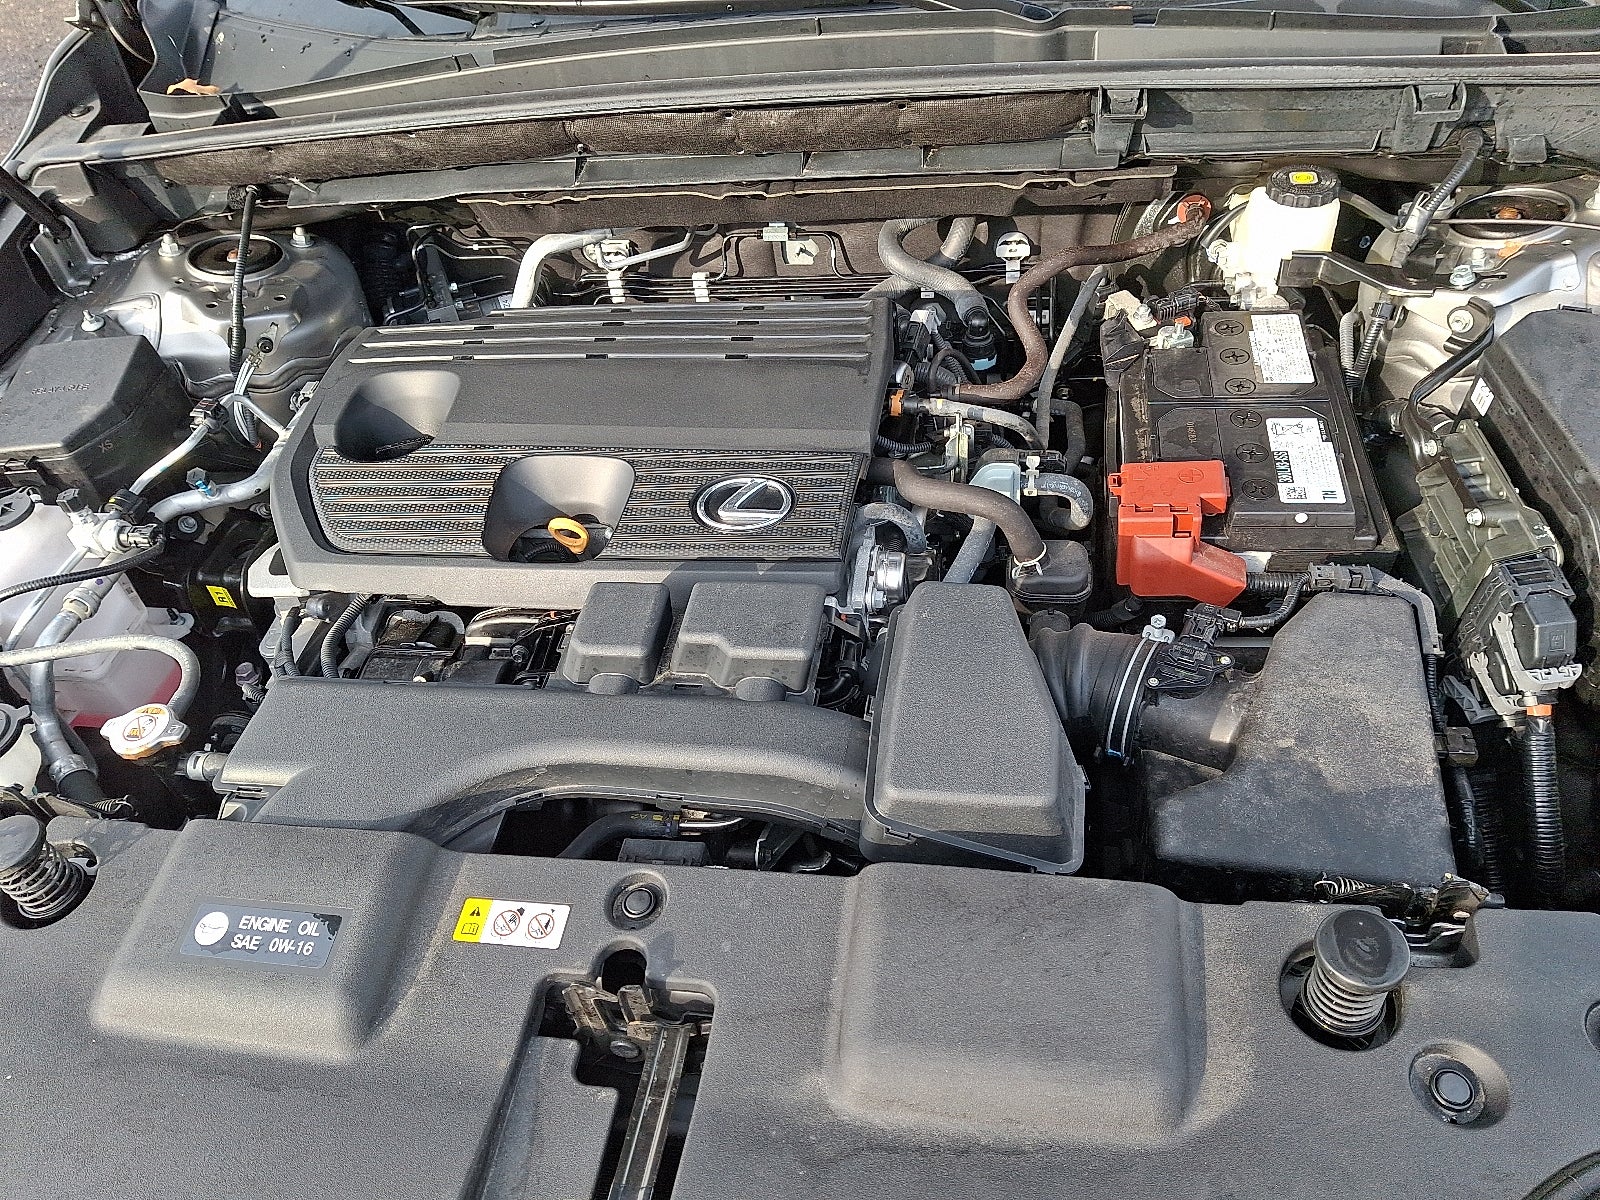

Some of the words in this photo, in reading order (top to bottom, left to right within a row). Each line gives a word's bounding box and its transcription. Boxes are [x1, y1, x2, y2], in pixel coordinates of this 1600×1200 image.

[238, 915, 292, 934] ENGINE
[297, 921, 320, 937] OIL
[231, 934, 262, 951] SAE
[268, 938, 315, 956] 0W-16
